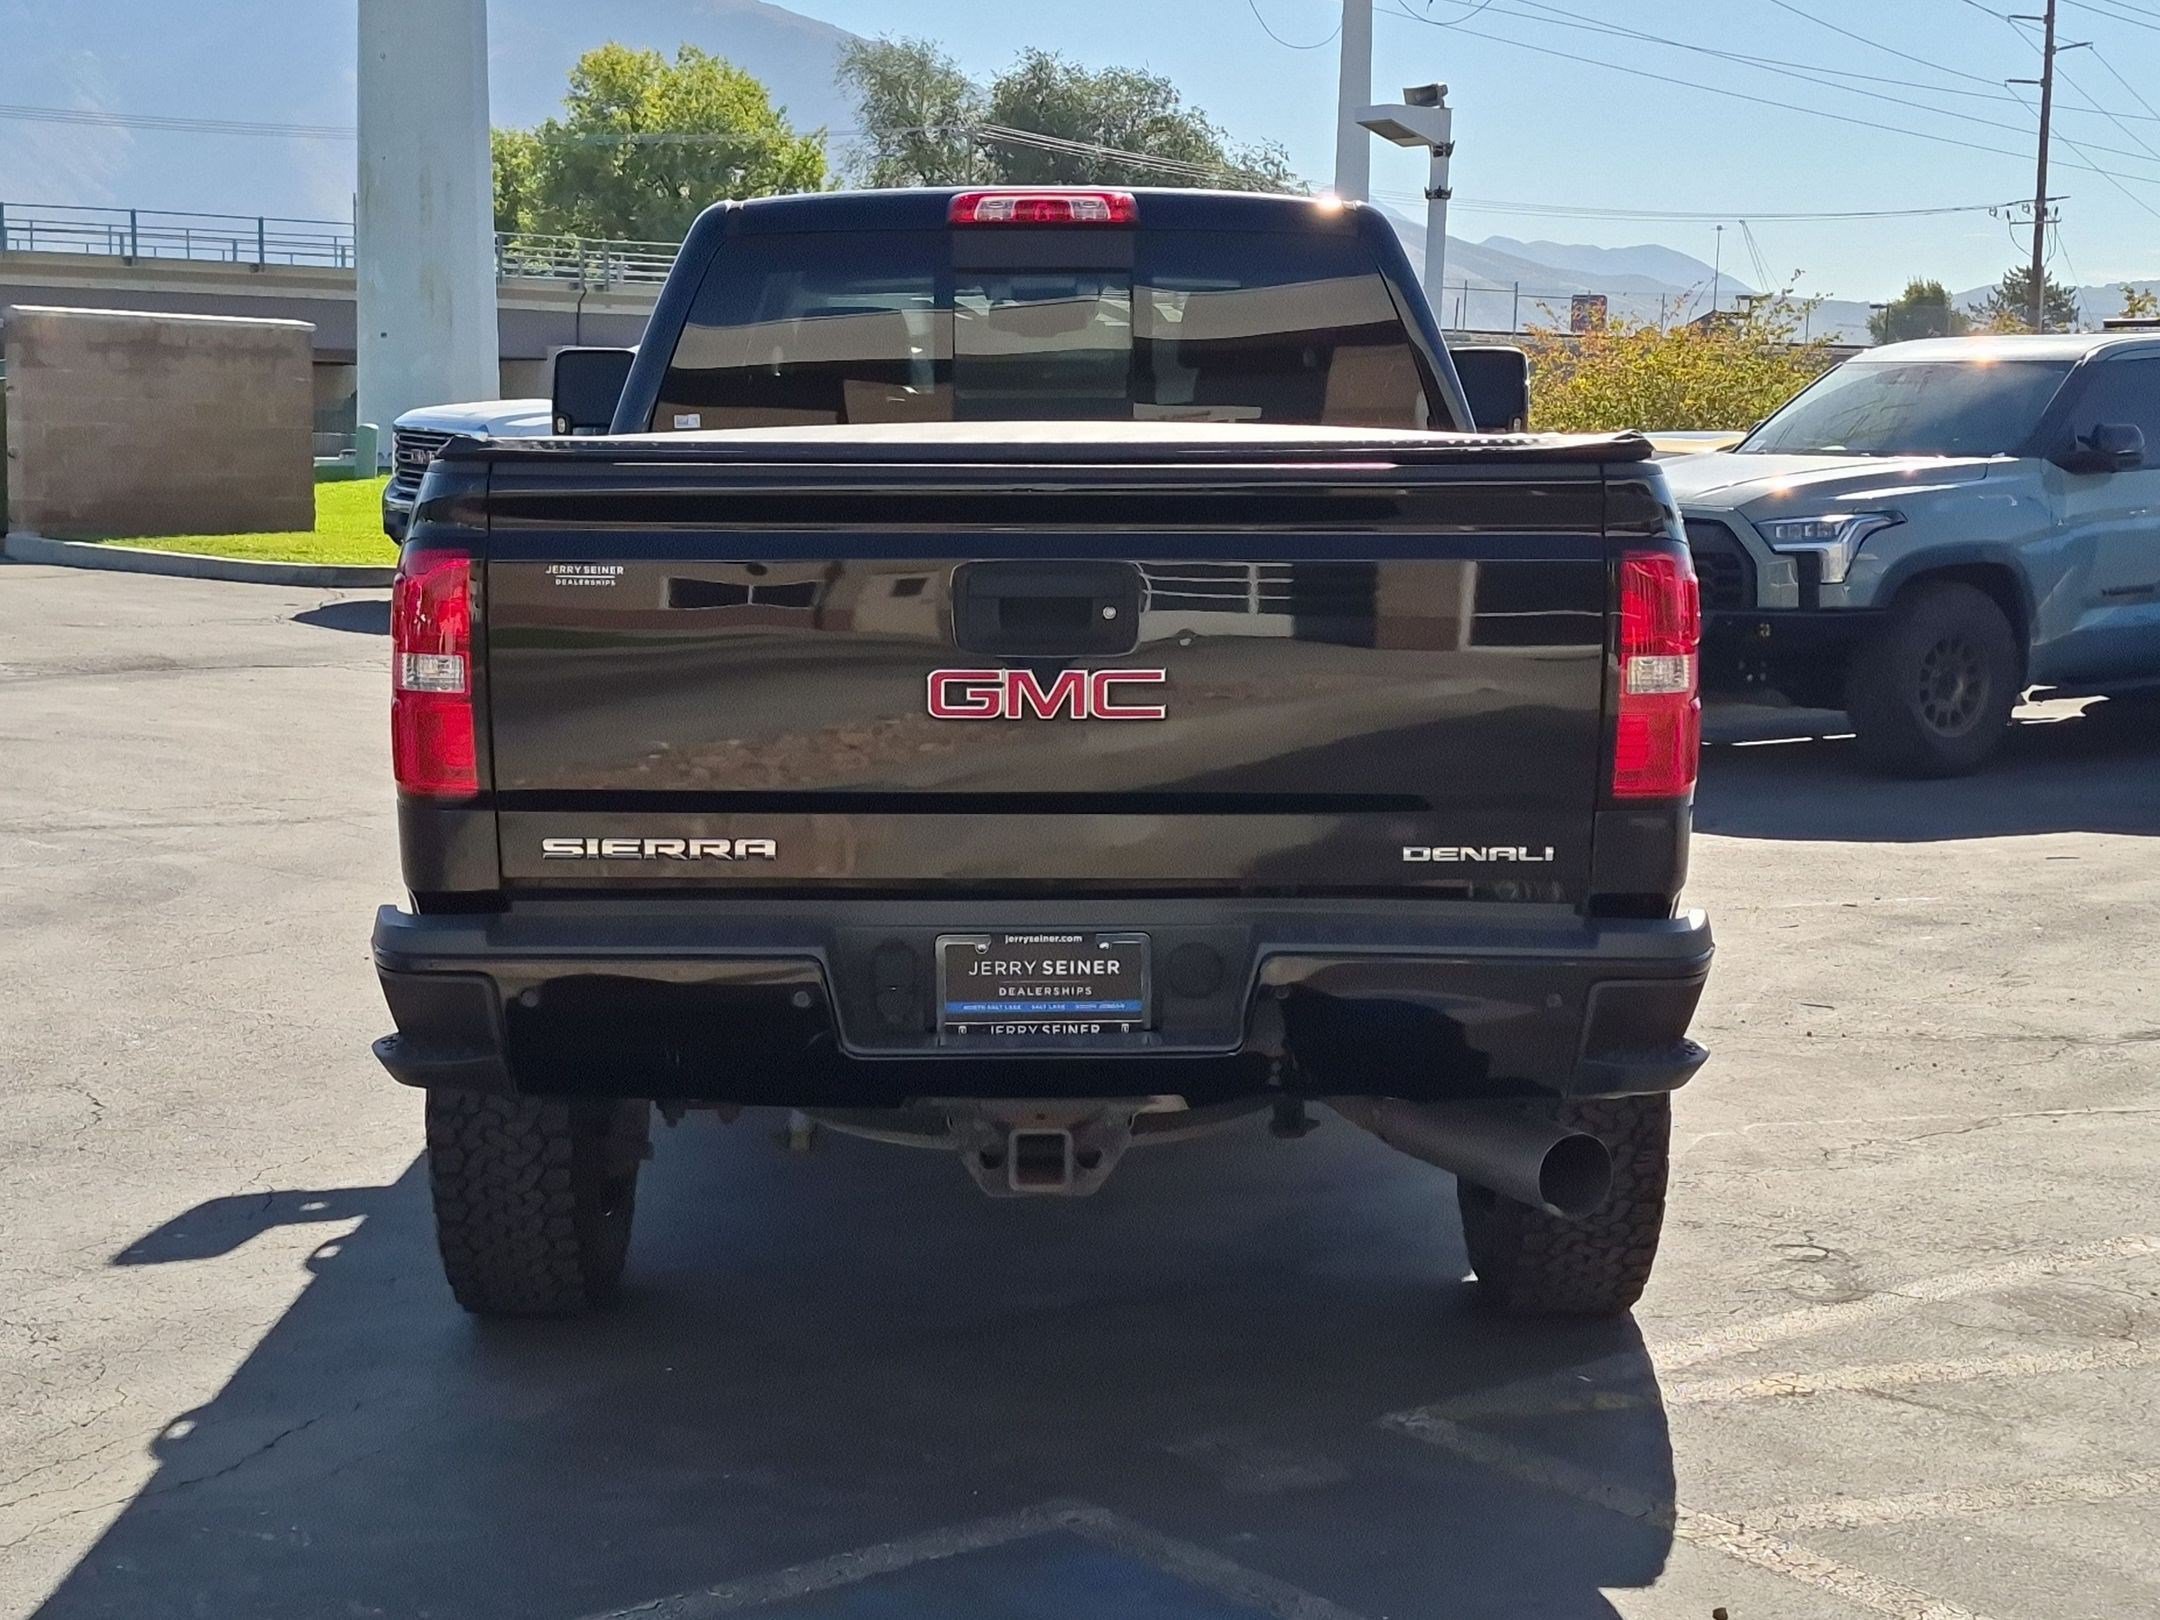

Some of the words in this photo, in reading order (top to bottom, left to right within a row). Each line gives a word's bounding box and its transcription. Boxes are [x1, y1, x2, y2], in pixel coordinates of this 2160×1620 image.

[545, 565, 582, 574] JERRY
[583, 565, 624, 575] SEINER
[555, 578, 616, 586] DEALERSHIPS
[927, 668, 1167, 719] GMC
[542, 838, 777, 860] SIERRA
[1402, 846, 1555, 862] DENALI
[1005, 934, 1083, 945] jerryseiner.com
[968, 960, 1037, 976] JERRY
[1041, 959, 1121, 975] SEINER
[998, 986, 1092, 997] DEALERSHIPS
